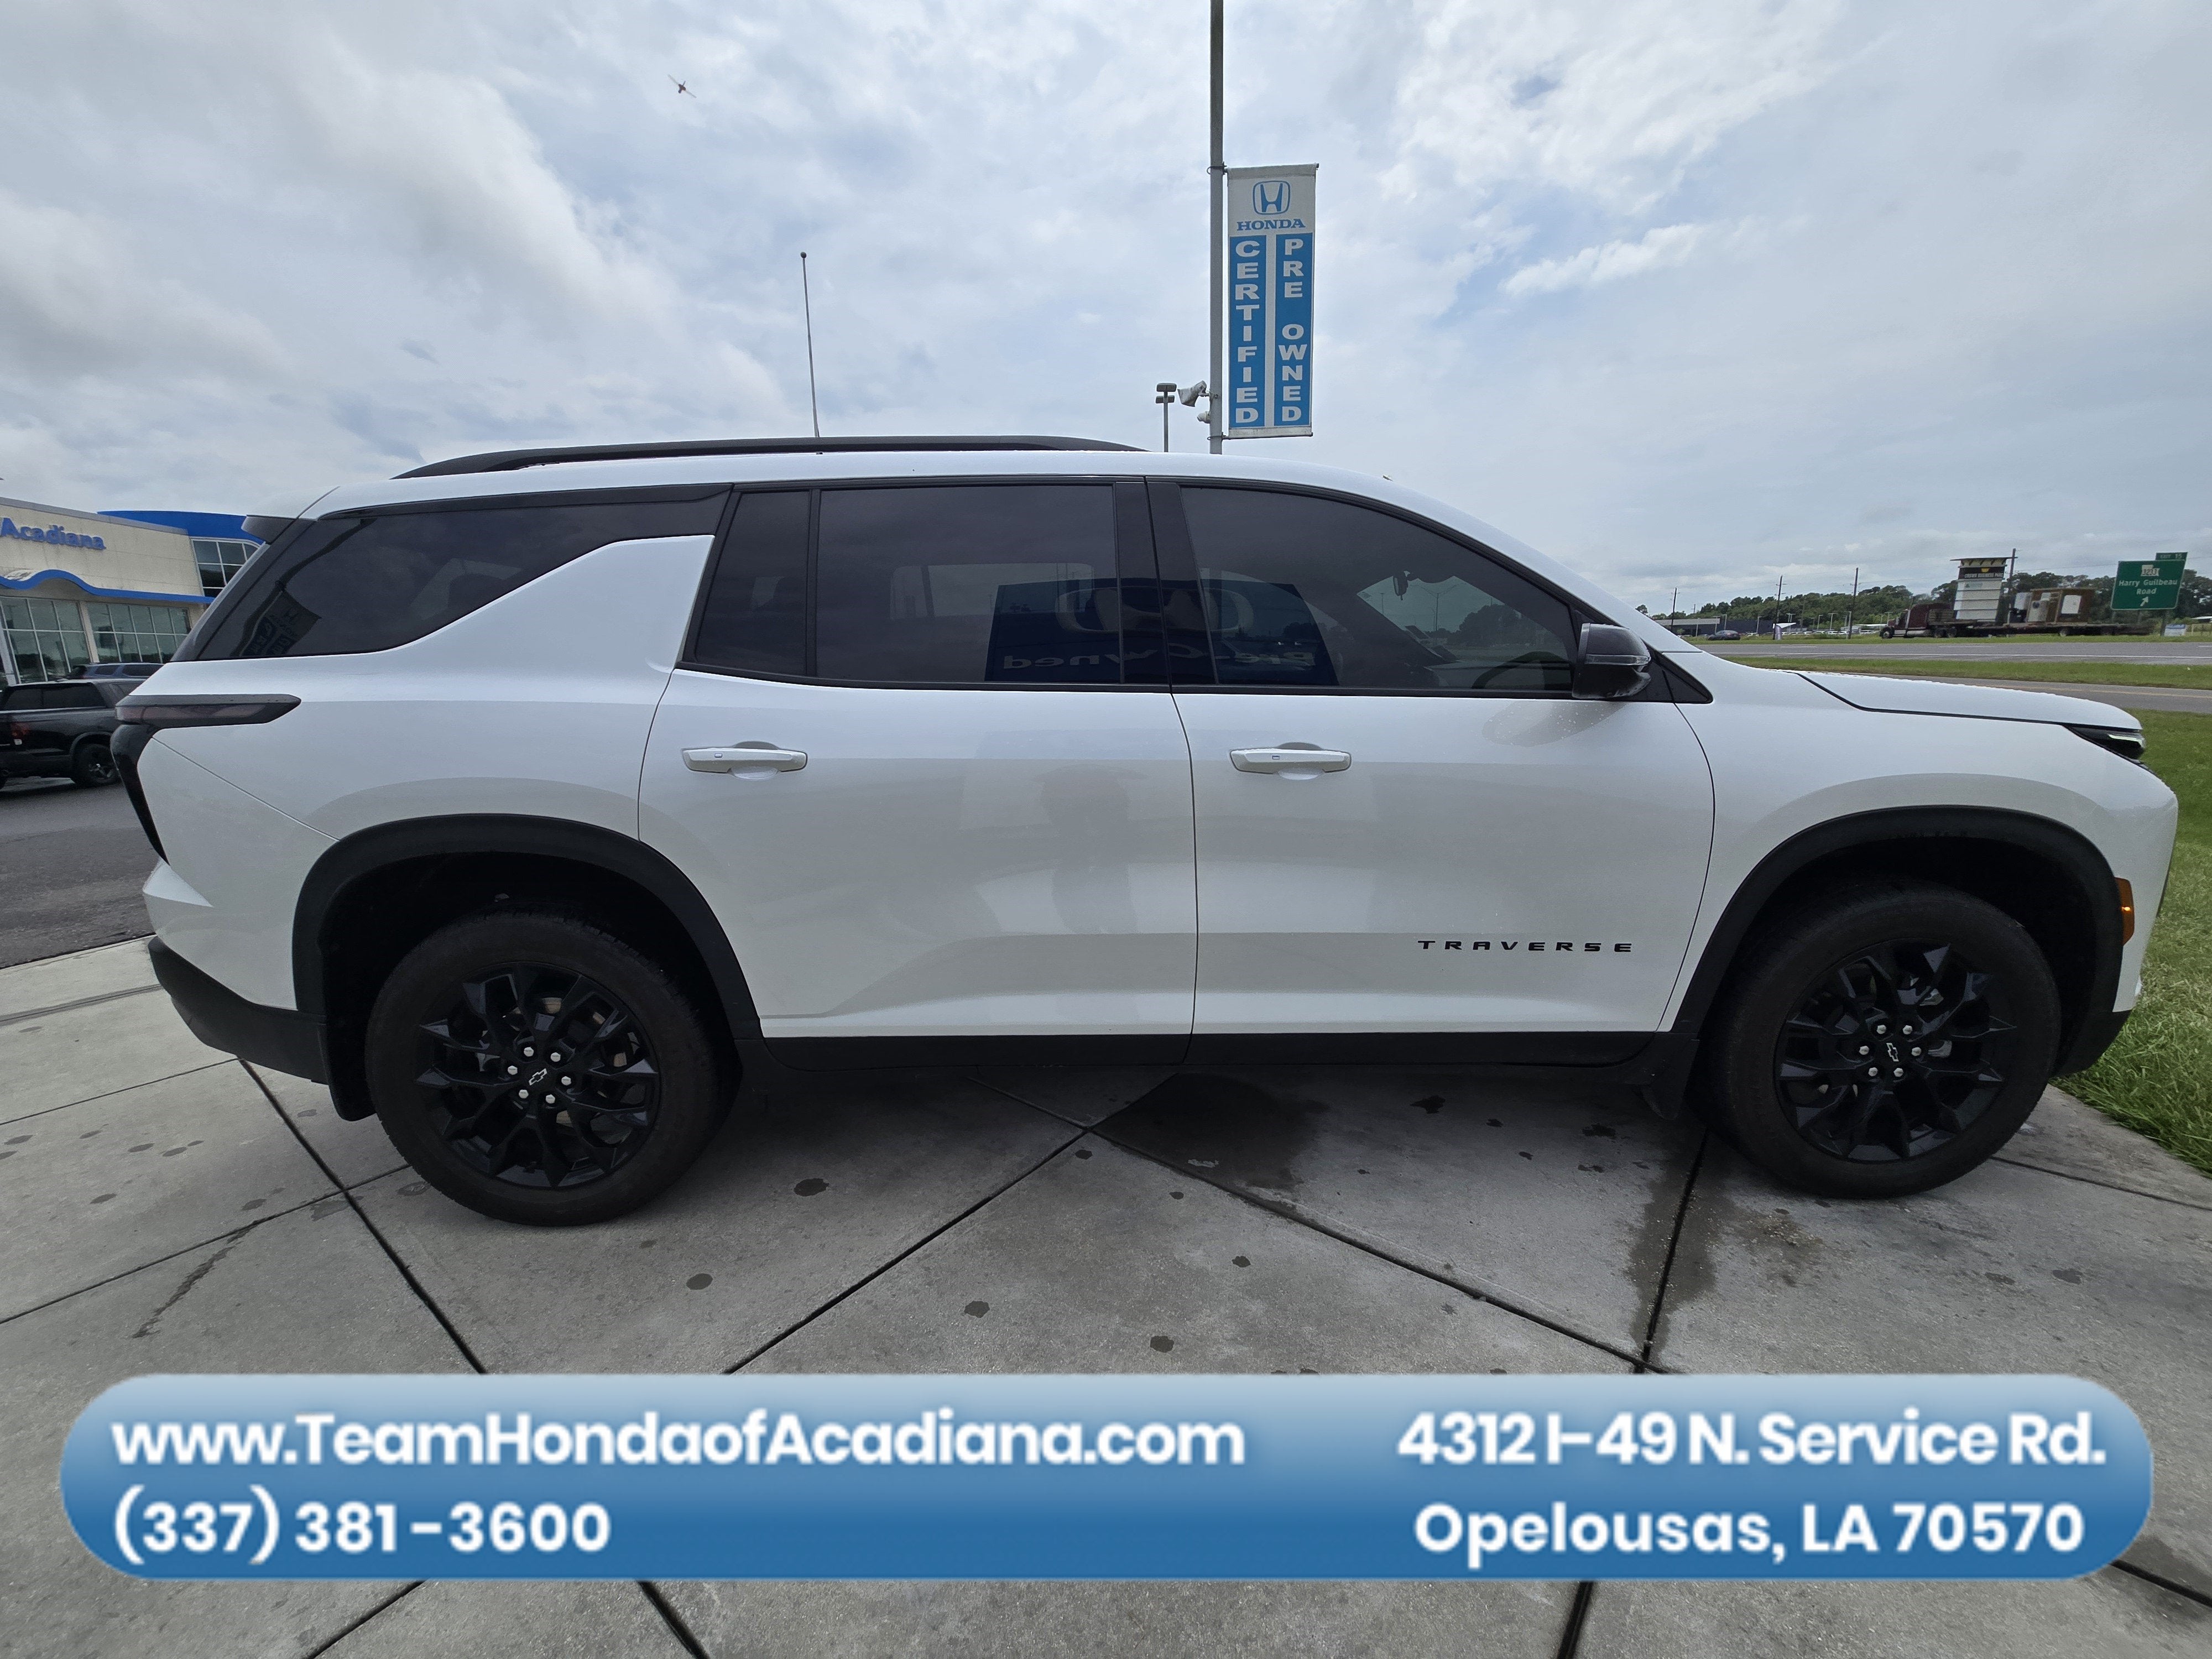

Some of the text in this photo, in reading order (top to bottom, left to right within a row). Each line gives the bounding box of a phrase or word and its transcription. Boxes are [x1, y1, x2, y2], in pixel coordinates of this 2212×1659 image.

[1237, 218, 1306, 231] HONDA
[1235, 240, 1260, 424] CERTIFIED
[1279, 238, 1307, 422] PRE OWNED
[1, 518, 106, 550] Acadiana
[1417, 940, 1632, 952] TRAVERSE
